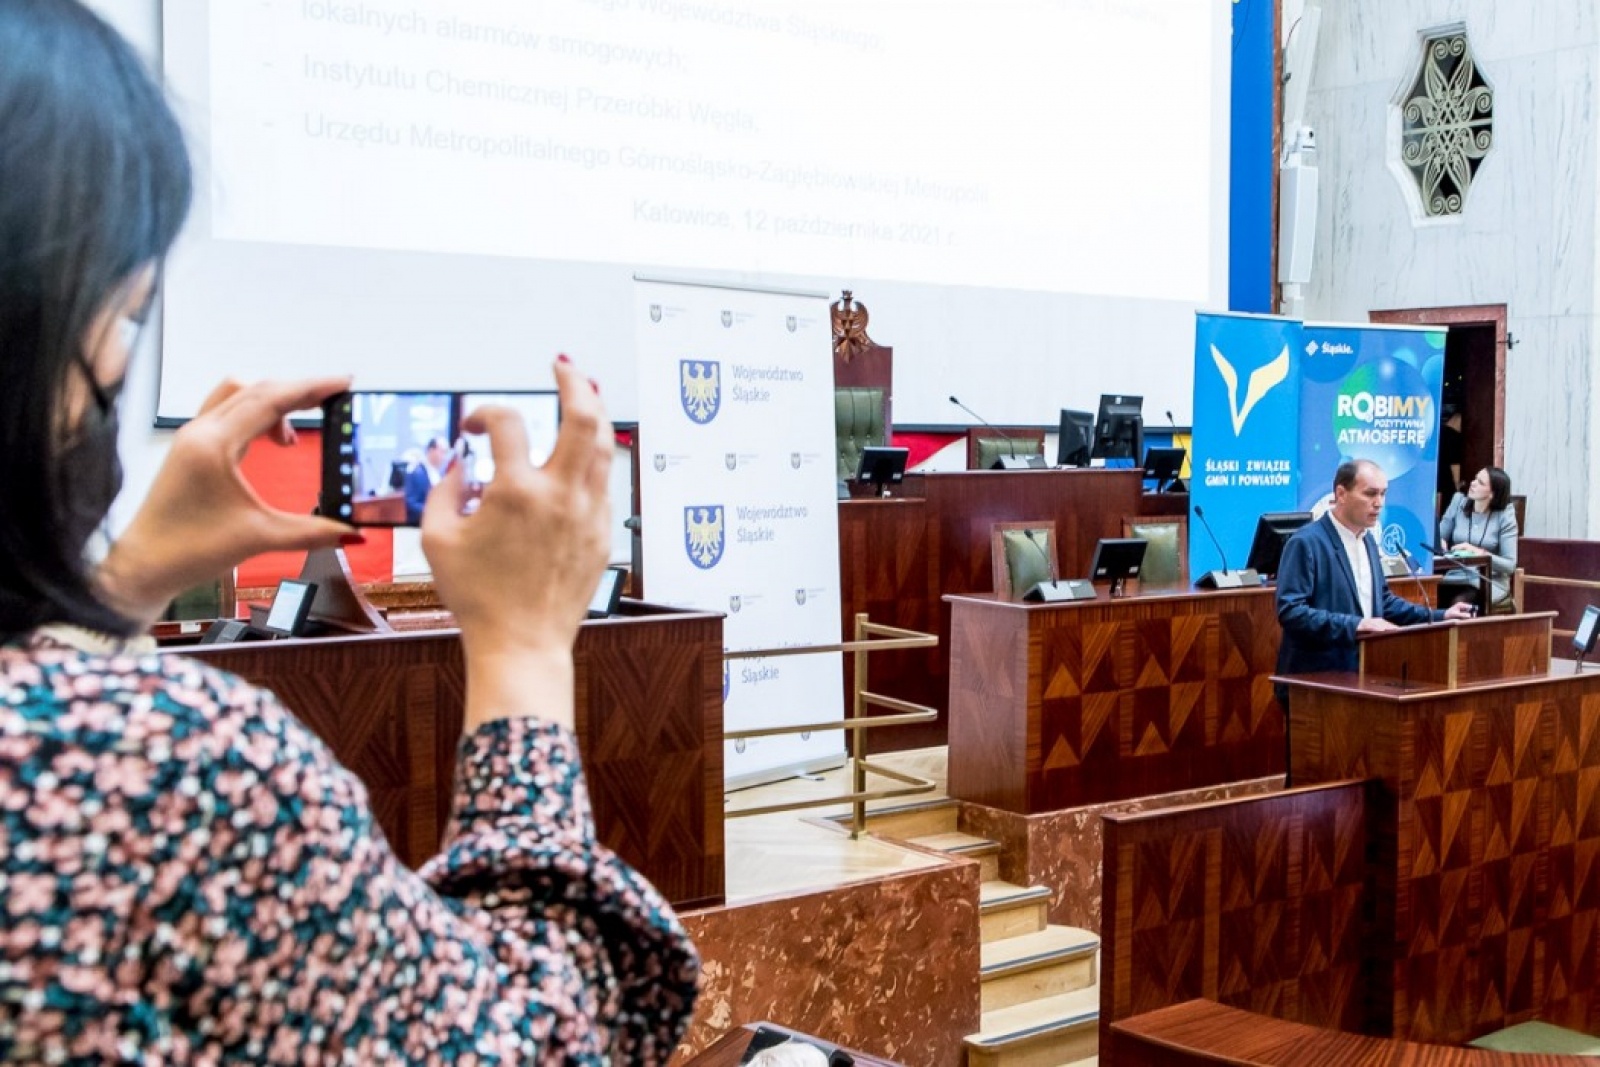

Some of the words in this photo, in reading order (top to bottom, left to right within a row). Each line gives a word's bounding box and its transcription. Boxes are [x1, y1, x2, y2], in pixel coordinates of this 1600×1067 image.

[302, 0, 427, 36] lokalnych
[435, 14, 541, 51] alarmów
[303, 53, 417, 90] Instytutu
[425, 68, 568, 114] Chemicznej
[303, 112, 401, 148] Urzędu
[409, 124, 611, 170] Metropolitalnego
[743, 207, 768, 232] 12
[899, 221, 940, 246] 2021
[731, 364, 804, 383] Województwo
[732, 383, 770, 404] Śląskie
[1337, 391, 1431, 423] ROBIMY
[1337, 428, 1426, 449] ATMOSFERĘ
[1205, 457, 1240, 473] ŚLĄSKI
[1246, 459, 1291, 473] ZWIĄZEK
[1205, 474, 1229, 487] GMIN
[1231, 474, 1237, 487] I
[1238, 472, 1291, 487] POWIATÓW
[736, 504, 808, 523] Województwo
[737, 526, 775, 545] Śląskie
[741, 665, 780, 686] Śląskie
